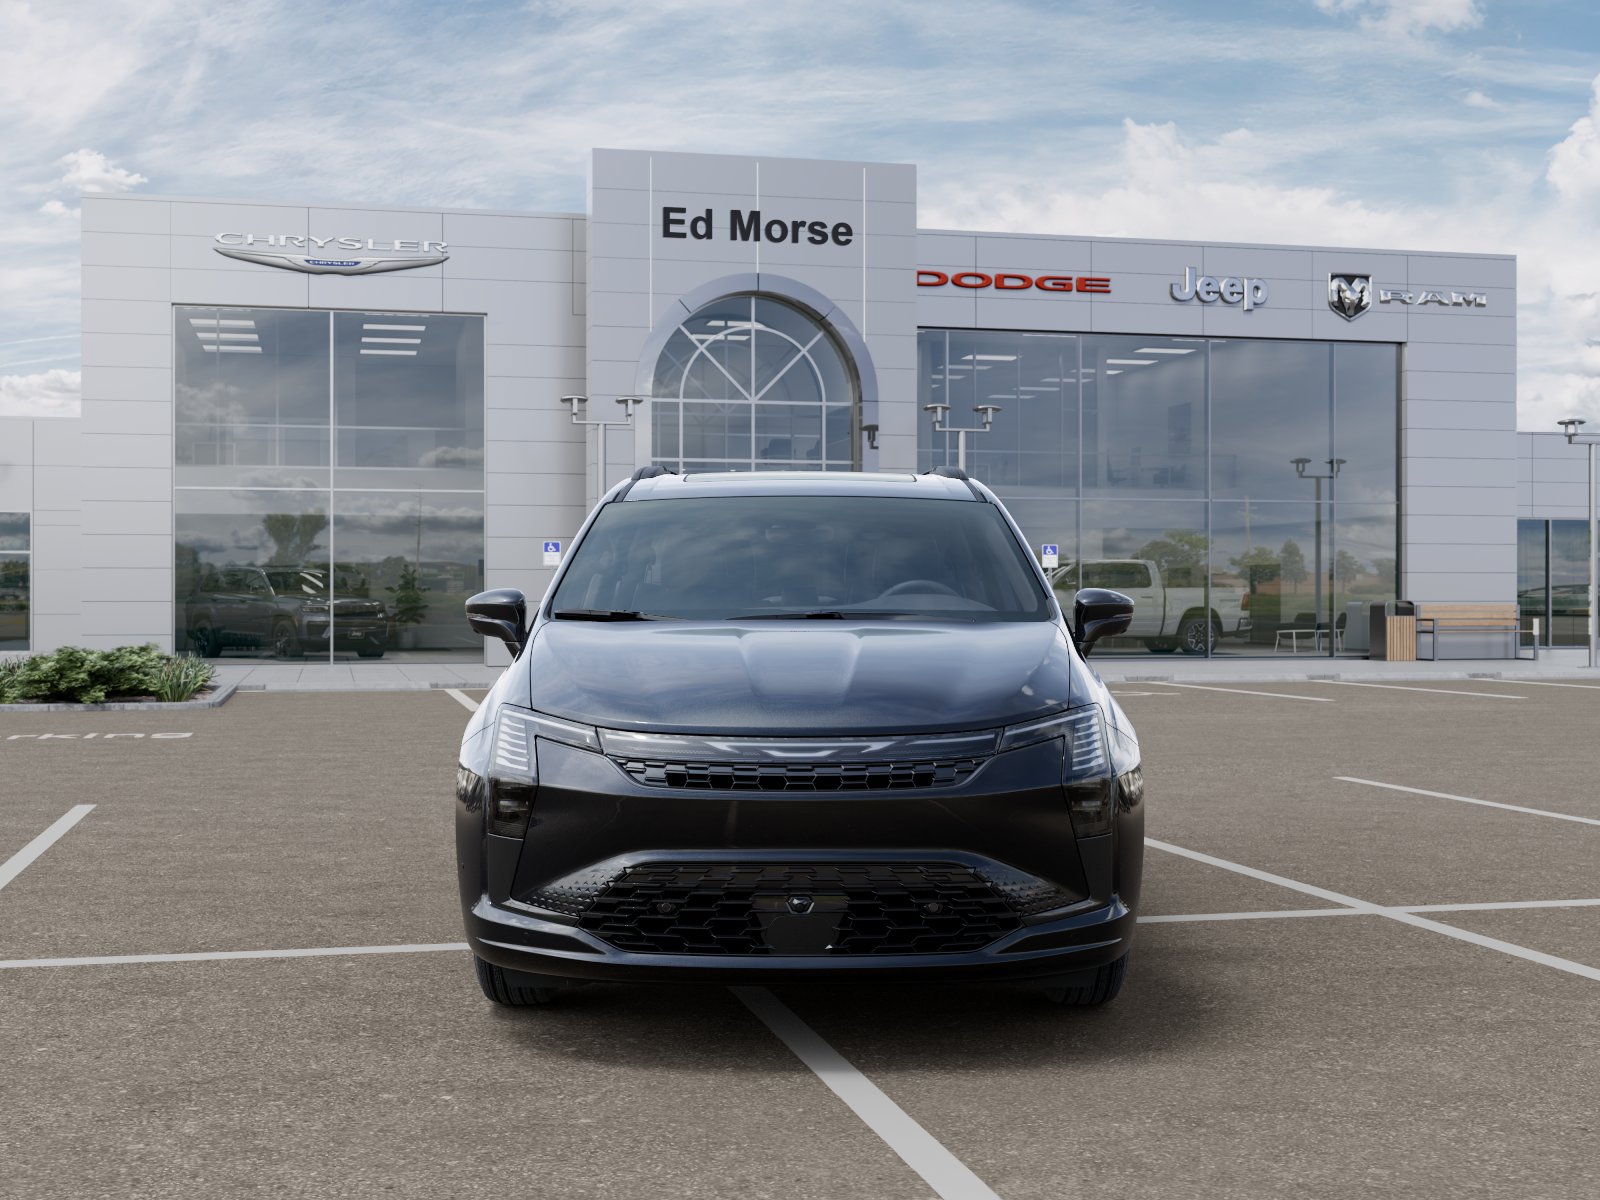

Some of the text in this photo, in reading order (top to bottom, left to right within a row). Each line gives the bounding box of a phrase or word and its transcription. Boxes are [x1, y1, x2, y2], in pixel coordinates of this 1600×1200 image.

[662, 206, 854, 247] Ed Morse
[214, 232, 449, 253] CHRYSLER
[916, 270, 1112, 294] DODGE
[1170, 266, 1268, 312] Jeep
[1379, 288, 1487, 308] RAM
